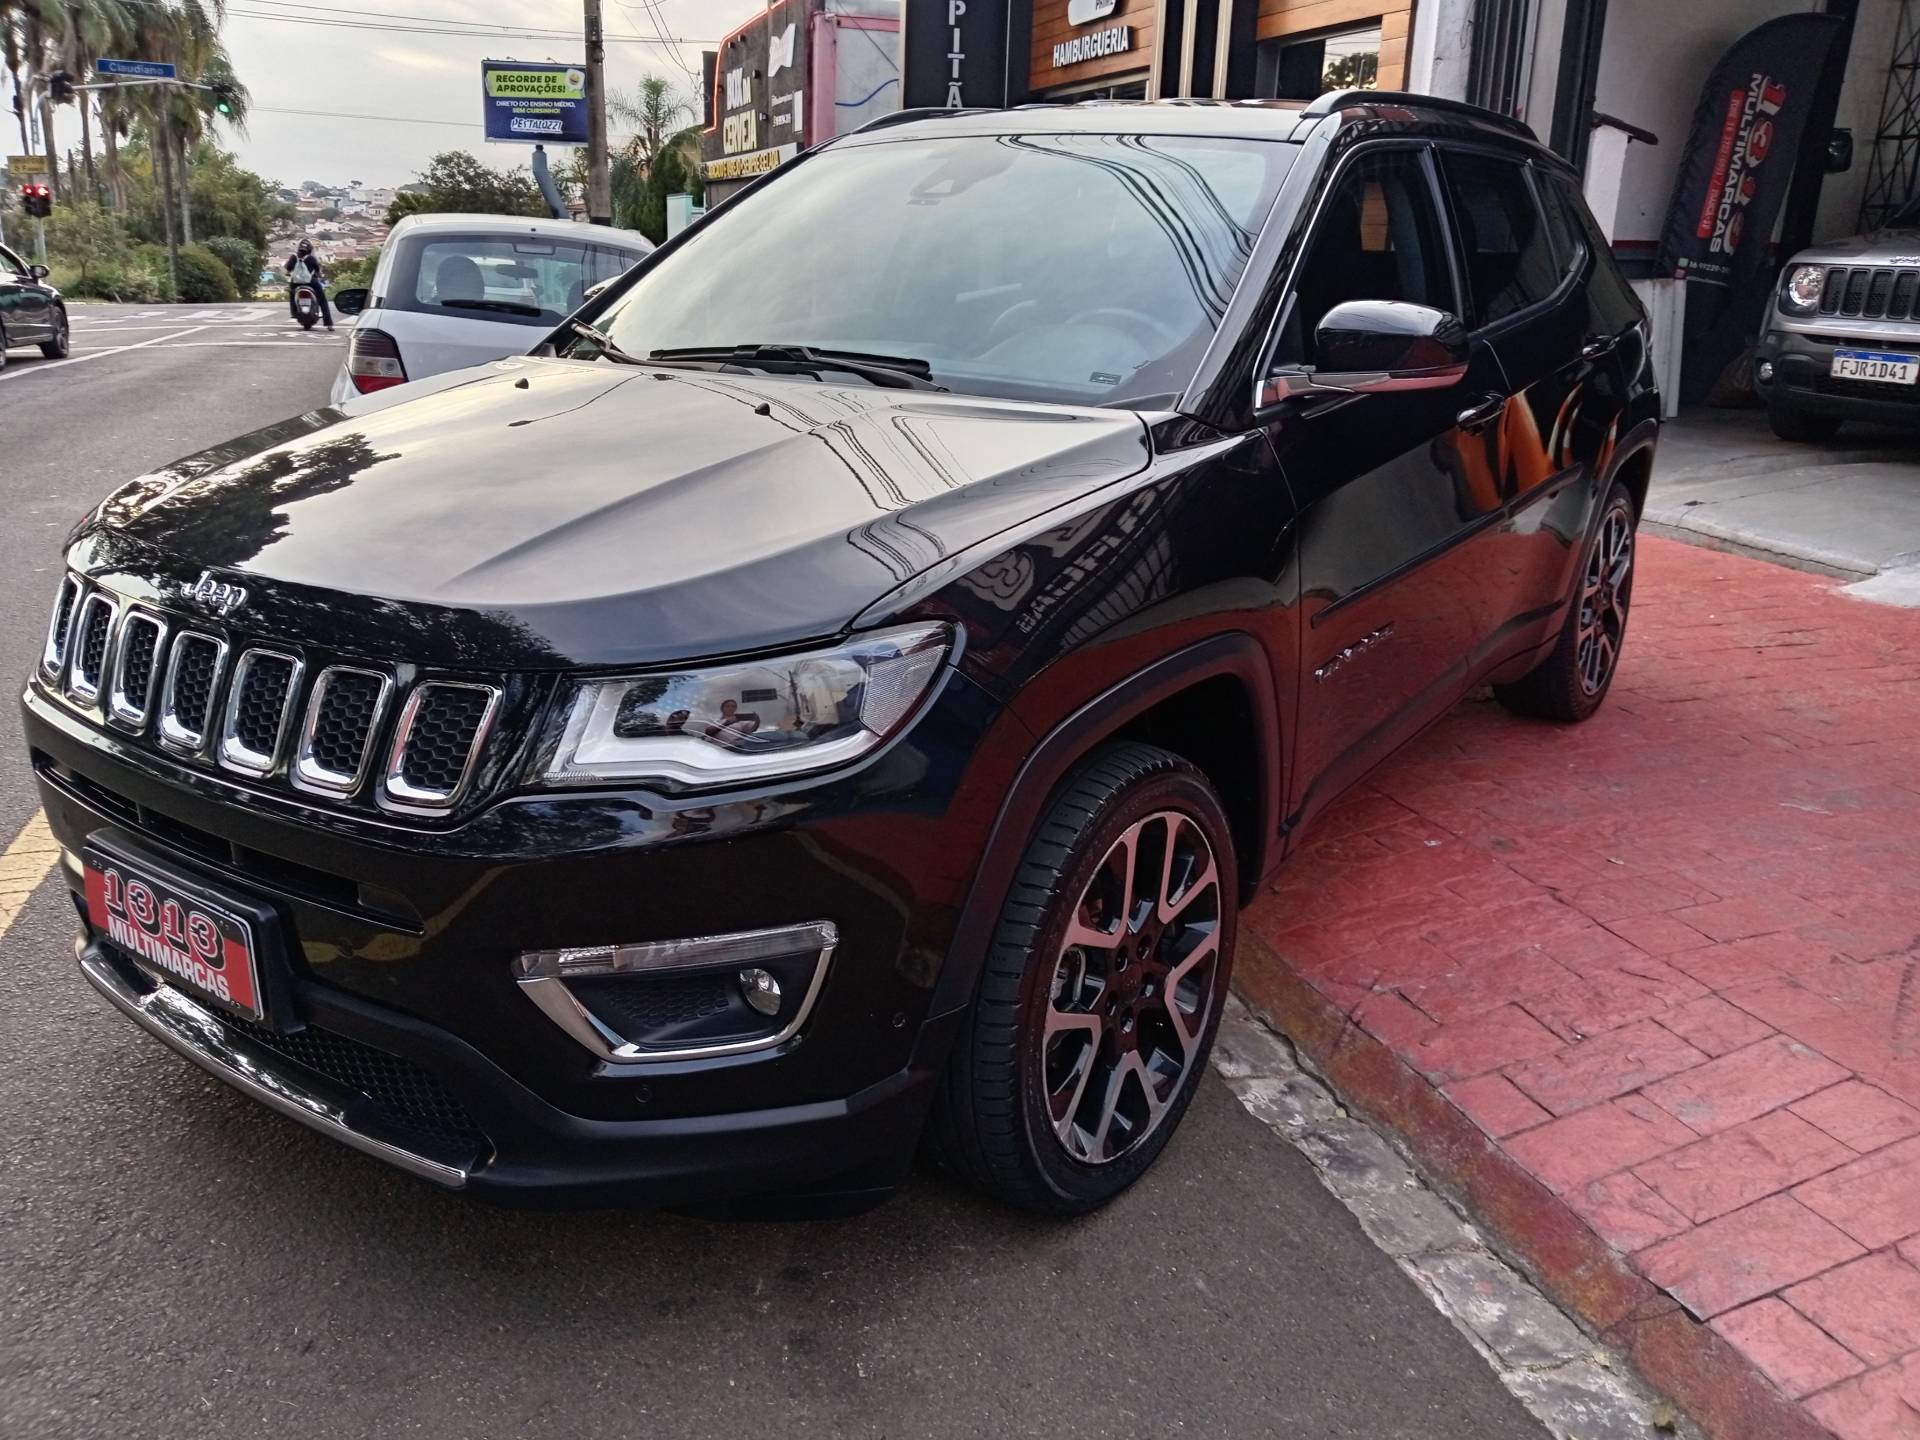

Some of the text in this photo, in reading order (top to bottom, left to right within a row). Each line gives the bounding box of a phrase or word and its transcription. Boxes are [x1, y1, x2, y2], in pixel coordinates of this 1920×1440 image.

[1052, 25, 1129, 67] HAMBURGUERIA
[495, 75, 557, 83] RECORDE DE
[496, 83, 566, 94] APROVAÇÕES!
[723, 109, 757, 155] CERVEJA
[1709, 73, 1763, 253] MULTIMARCAS
[1840, 359, 1908, 380] FJR1D41
[180, 570, 247, 616] Jeep
[104, 867, 227, 971] 1313
[107, 914, 231, 1002] MULTIMARCAS
